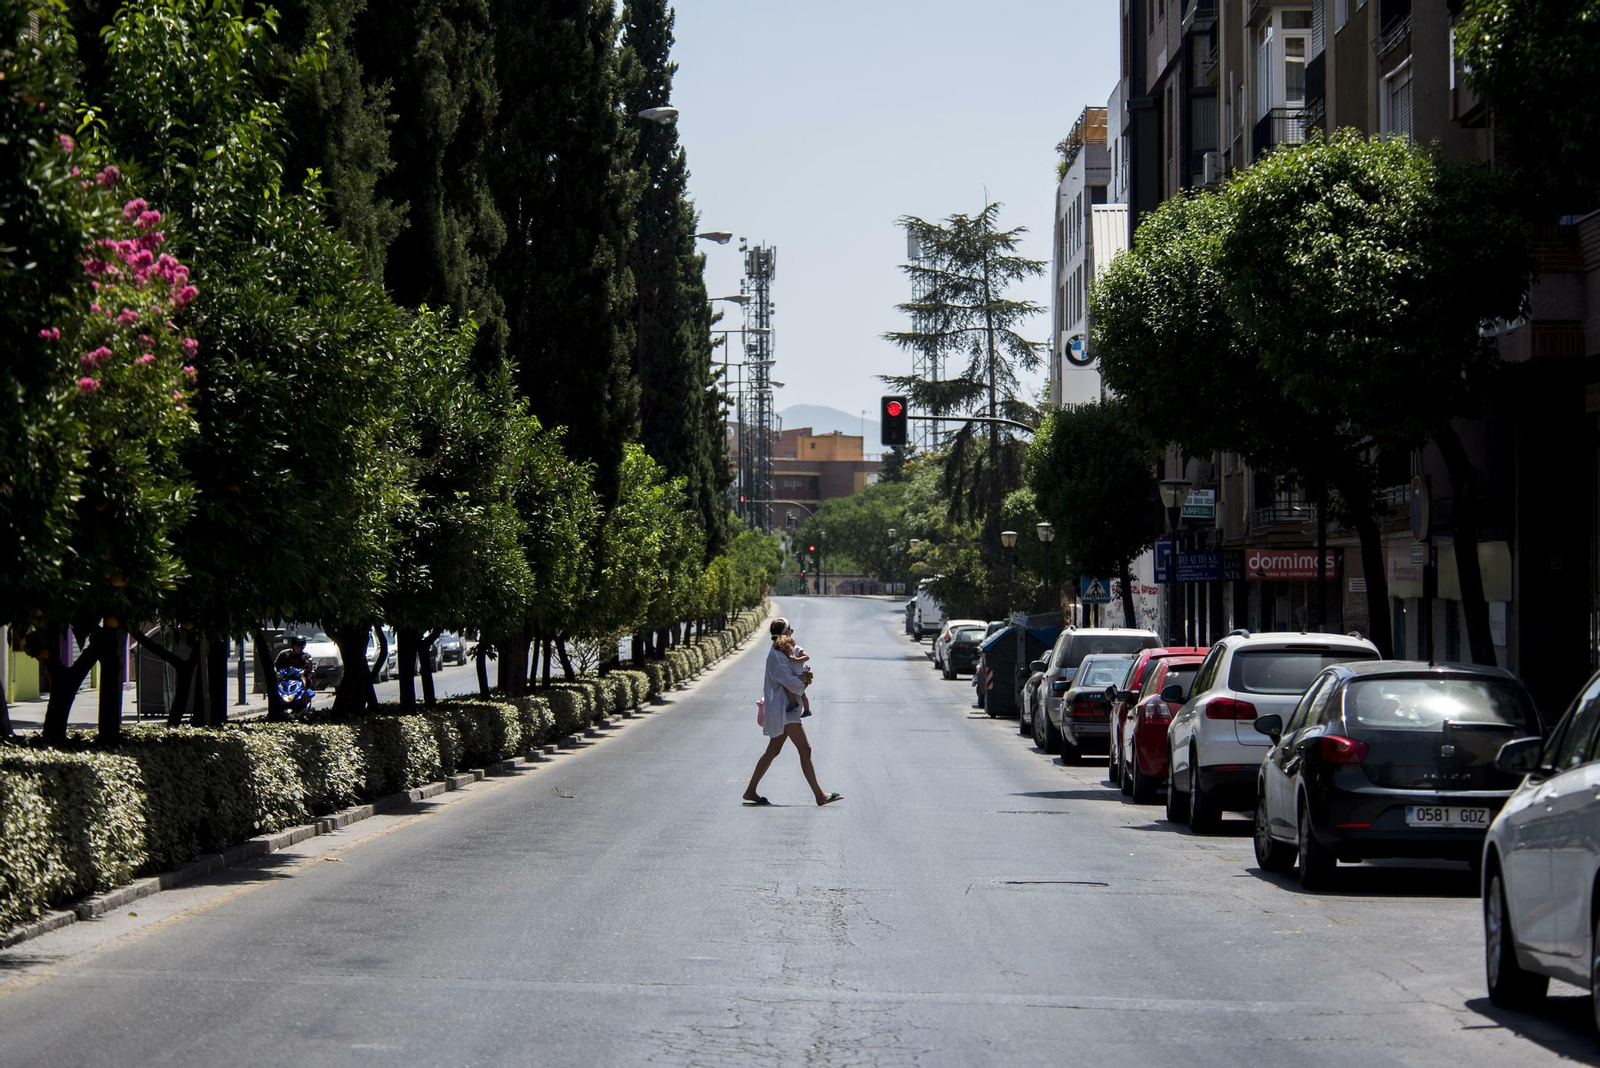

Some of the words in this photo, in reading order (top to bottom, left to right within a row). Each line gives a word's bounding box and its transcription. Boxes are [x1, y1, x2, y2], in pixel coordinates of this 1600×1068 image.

[1189, 554, 1207, 564] AUTO
[1417, 808, 1449, 822] 0581
[1460, 809, 1486, 823] GDZ
